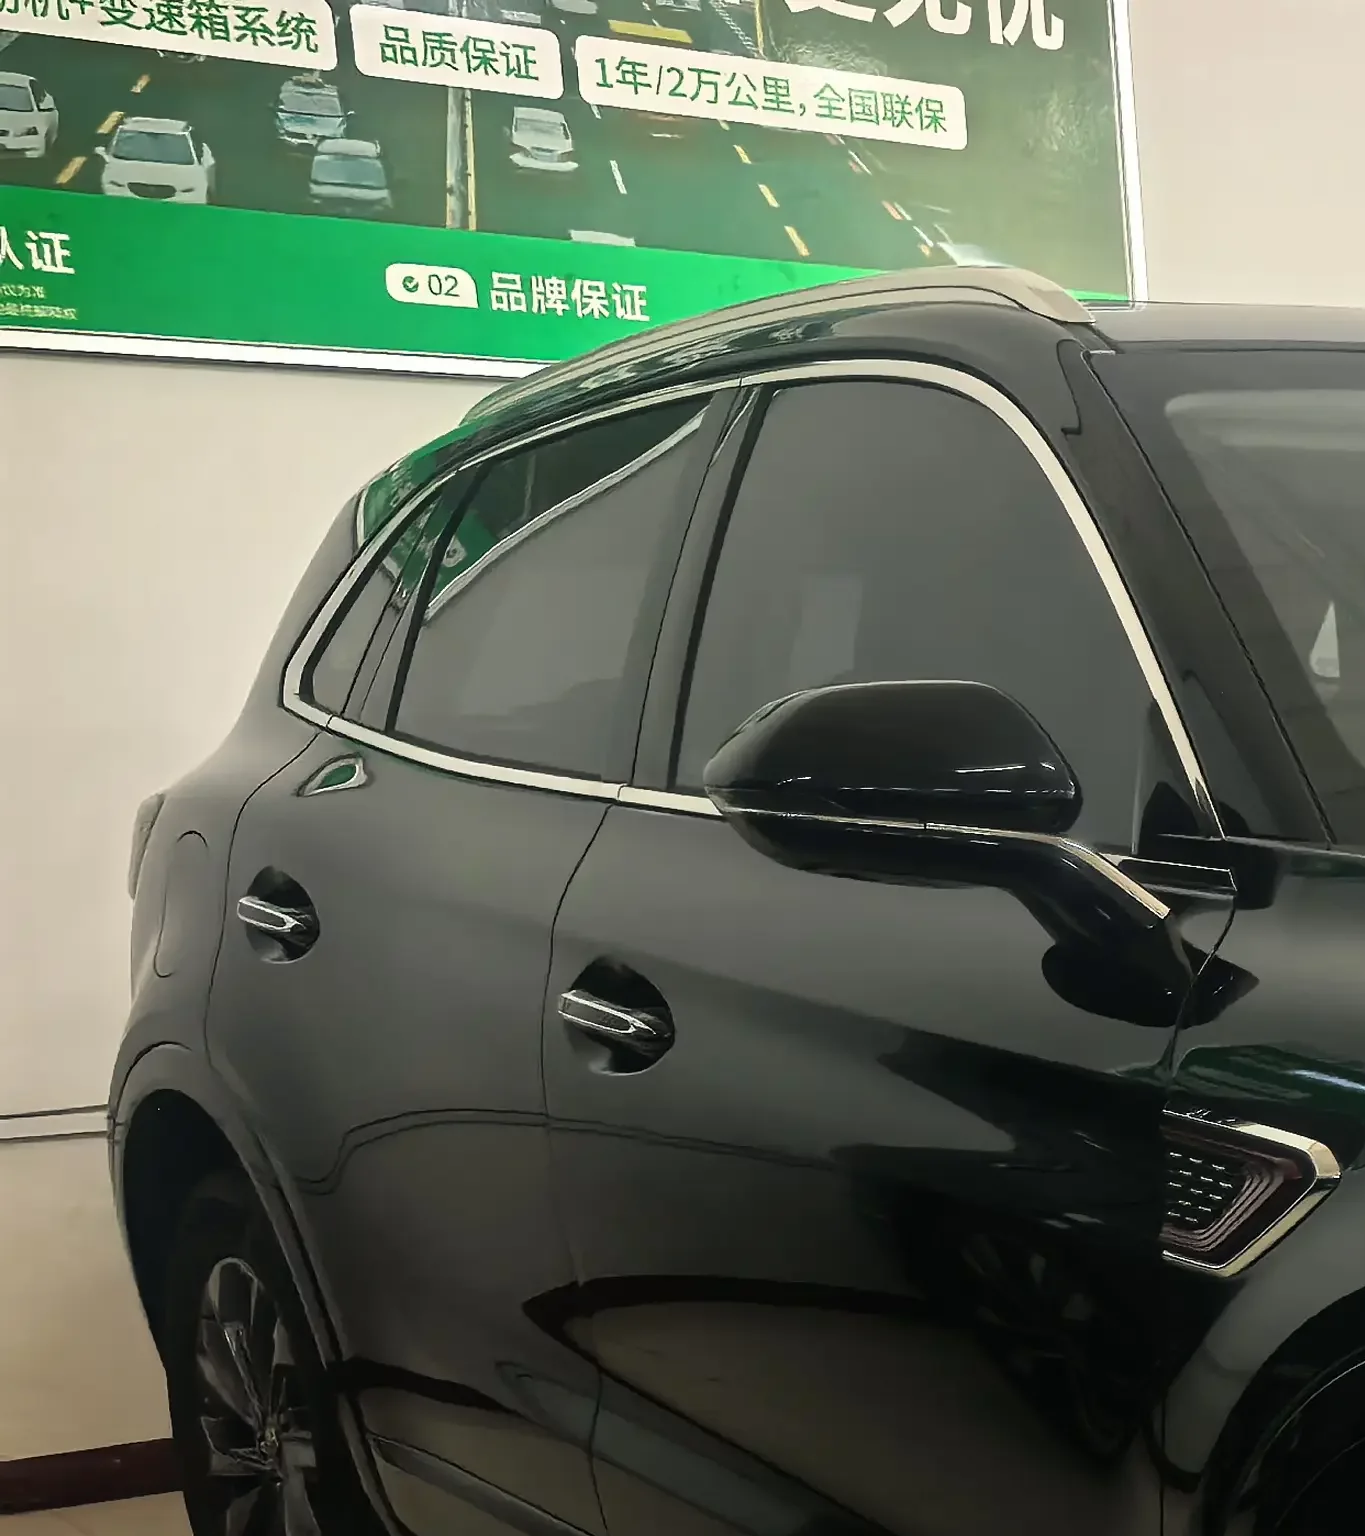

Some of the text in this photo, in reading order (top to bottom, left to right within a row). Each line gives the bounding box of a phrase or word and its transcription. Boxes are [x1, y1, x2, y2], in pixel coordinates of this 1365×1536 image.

[379, 24, 539, 82] 品质保证
[427, 273, 461, 298] 02
[489, 271, 651, 322] 品牌保证
